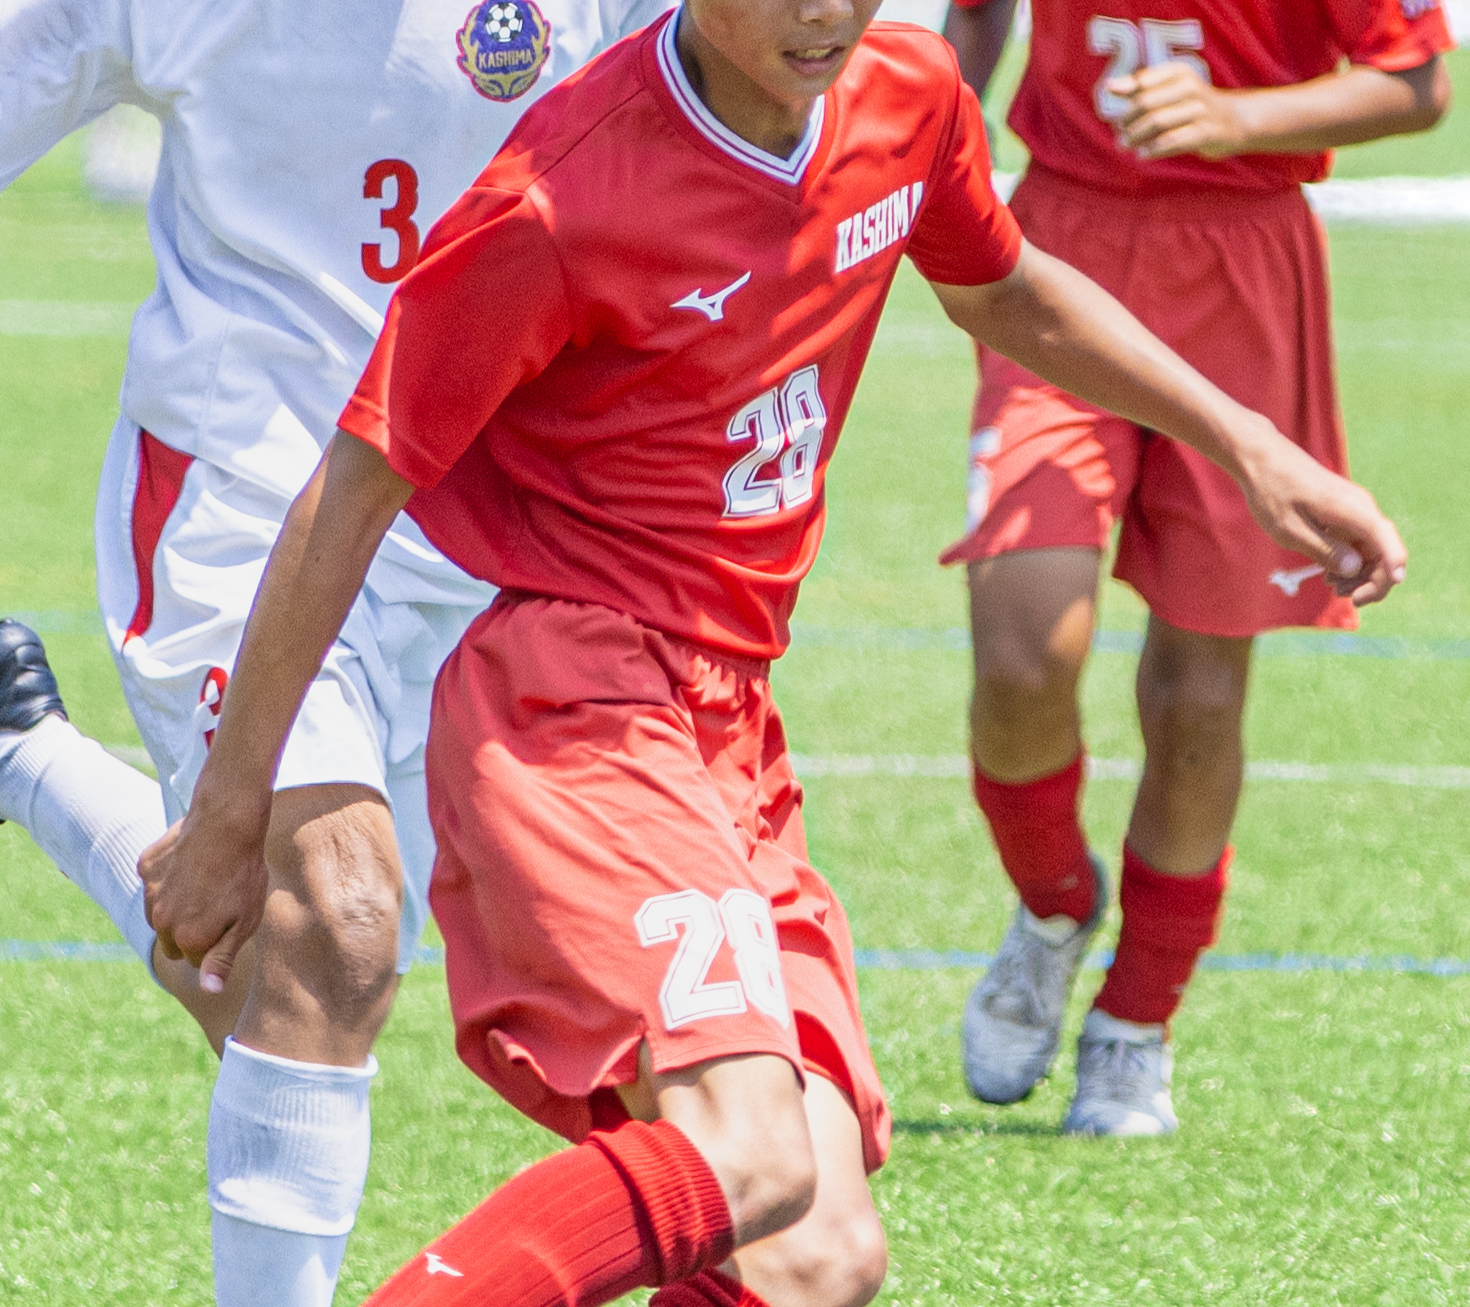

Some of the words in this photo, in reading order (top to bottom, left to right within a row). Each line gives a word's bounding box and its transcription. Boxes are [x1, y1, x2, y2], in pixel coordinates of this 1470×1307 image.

[477, 48, 534, 69] KASHIMA
[361, 158, 420, 284] 3
[721, 363, 827, 518] 28
[633, 888, 790, 1031] 28
